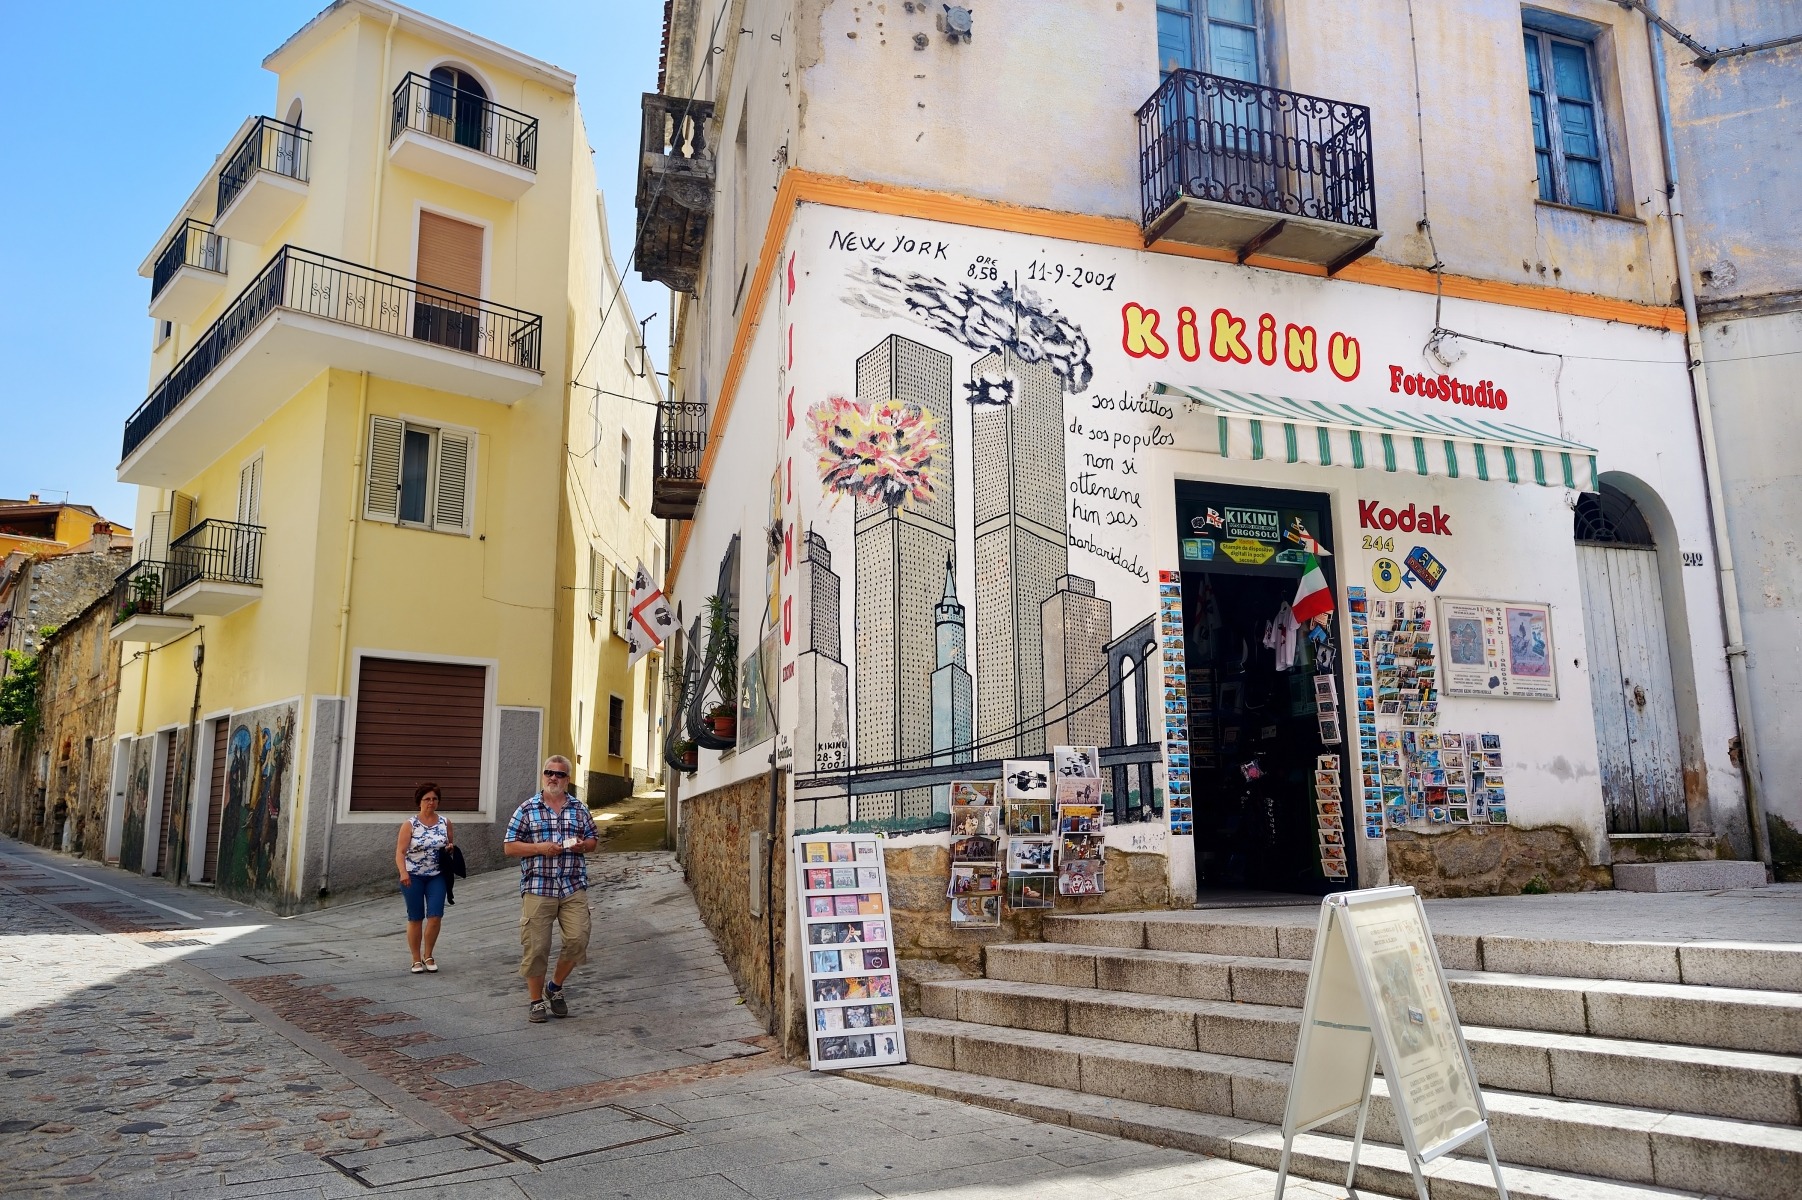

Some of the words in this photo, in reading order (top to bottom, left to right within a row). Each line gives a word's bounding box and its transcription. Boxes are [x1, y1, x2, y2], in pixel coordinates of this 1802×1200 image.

[829, 230, 885, 253] NEW
[893, 235, 950, 260] YORK
[976, 255, 998, 267] ORE
[1028, 260, 1117, 292] 11-9-2001
[1389, 364, 1508, 411] FotoStudio
[1092, 394, 1115, 410] sos
[1119, 390, 1173, 419] dirittos
[1069, 416, 1084, 435] de
[1089, 428, 1109, 441] sos
[1113, 425, 1174, 452] populos
[1083, 453, 1114, 471] non
[1122, 458, 1138, 475] si
[1070, 472, 1142, 508] ottenene
[1106, 511, 1138, 528] sas
[1226, 511, 1277, 526] KIKINU
[1358, 499, 1453, 536] Kodak
[1231, 528, 1278, 539] ORGOSOLO
[1362, 534, 1395, 552] 244
[1379, 561, 1391, 569] CD
[1418, 552, 1430, 566] SD
[817, 742, 848, 752] KIKINU
[820, 760, 846, 770] 2001
